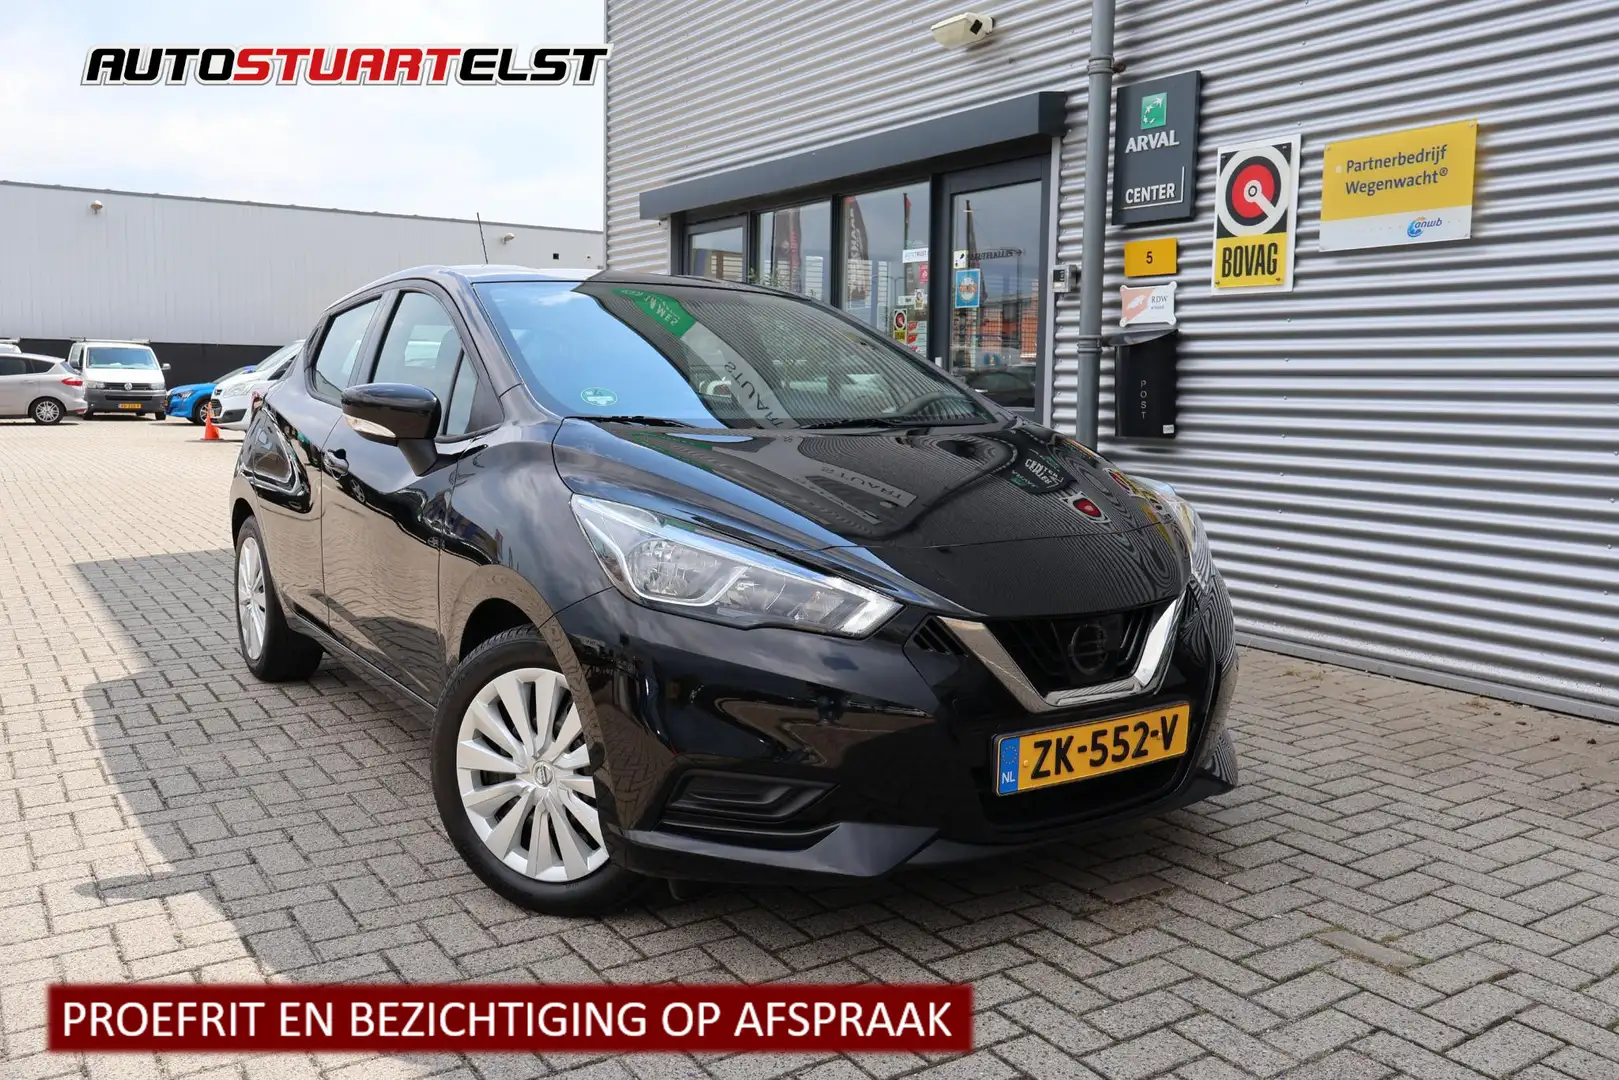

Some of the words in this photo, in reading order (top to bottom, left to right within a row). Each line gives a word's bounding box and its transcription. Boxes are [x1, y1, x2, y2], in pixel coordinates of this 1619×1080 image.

[1125, 130, 1180, 153] ARVAL
[1346, 144, 1448, 174] Partnerbedrijf
[1125, 183, 1176, 204] CENTER
[1414, 217, 1443, 229] anwb
[1145, 250, 1154, 265] 5
[1221, 242, 1279, 278] BOVAG
[1151, 295, 1169, 304] RDW
[1139, 379, 1148, 419] POST
[1030, 713, 1180, 780] ZK-552-V
[1001, 771, 1016, 784] NL
